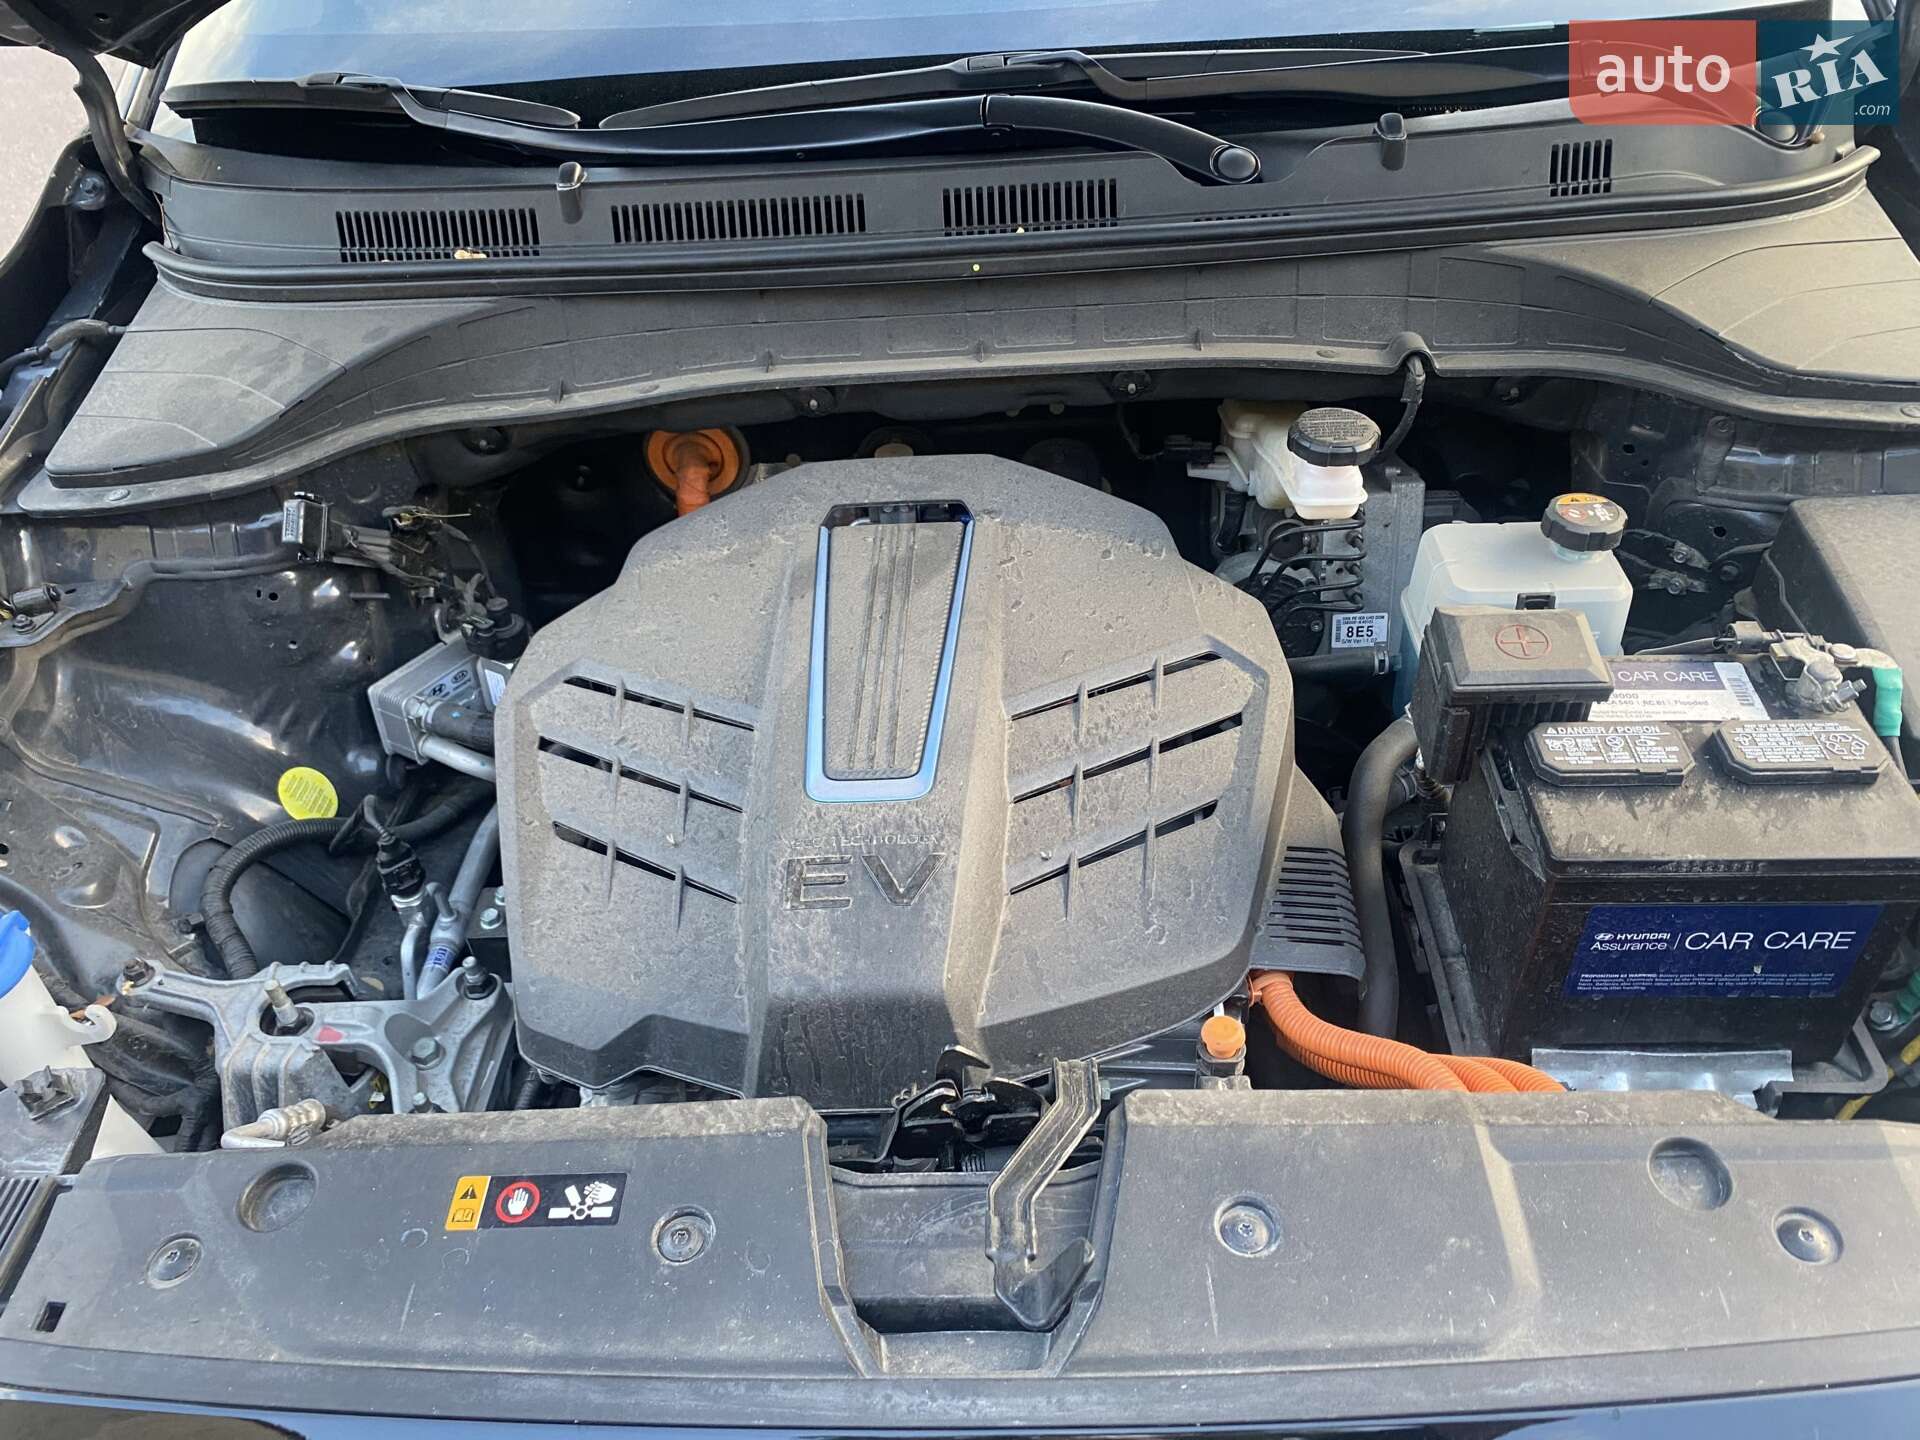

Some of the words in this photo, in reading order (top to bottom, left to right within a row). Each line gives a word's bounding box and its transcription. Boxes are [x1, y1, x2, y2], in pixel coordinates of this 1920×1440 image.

[1346, 625, 1374, 638] 8E5
[1617, 671, 1659, 682] CAR
[1663, 671, 1719, 682] CARE
[1557, 726, 1606, 734] DANGER
[1616, 725, 1661, 734] POISON
[783, 852, 947, 911] EV
[1590, 941, 1668, 951] Assurance
[1685, 931, 1754, 950] CAR
[1763, 931, 1856, 950] CARE
